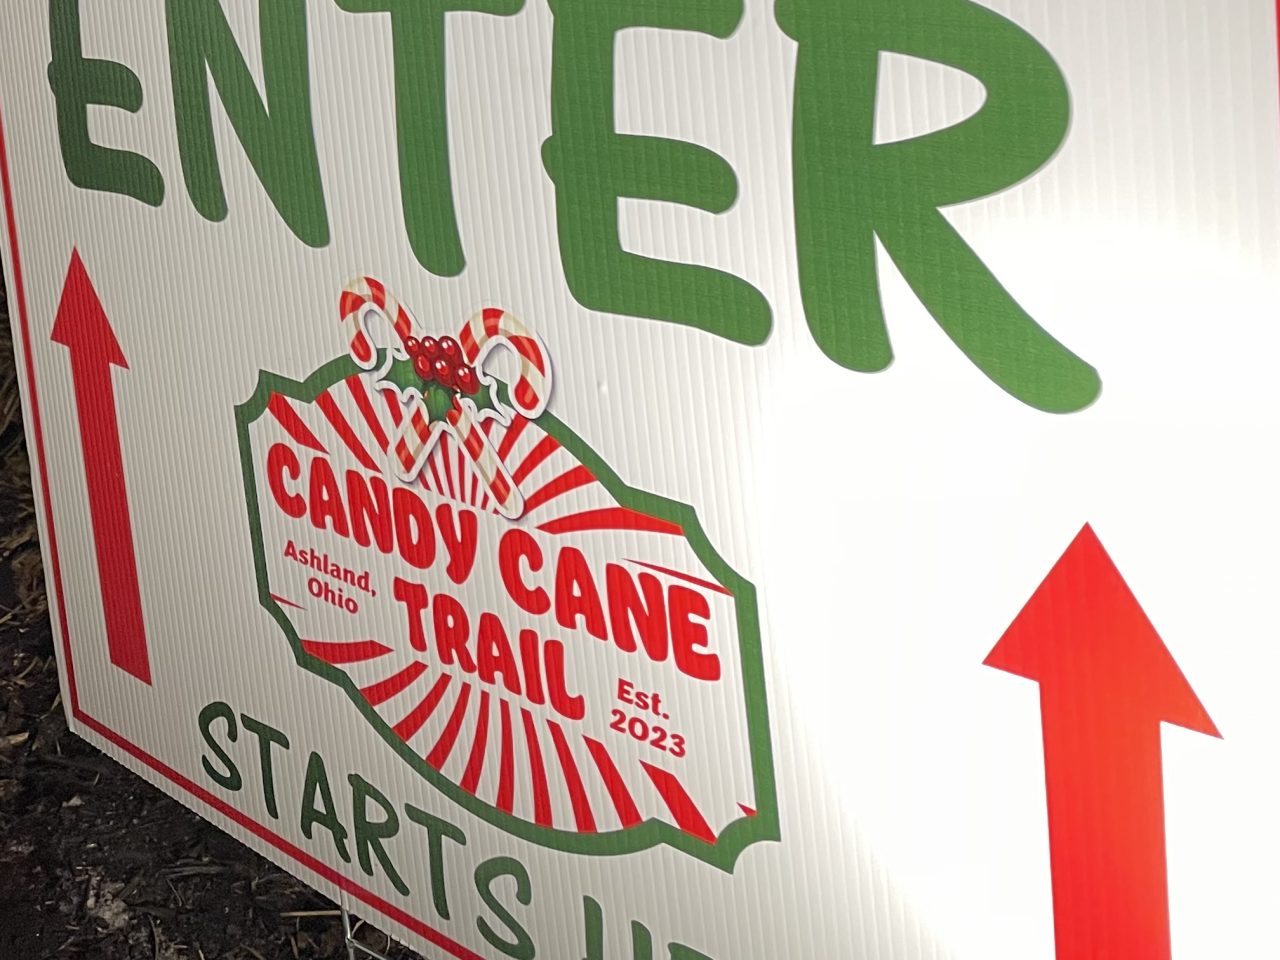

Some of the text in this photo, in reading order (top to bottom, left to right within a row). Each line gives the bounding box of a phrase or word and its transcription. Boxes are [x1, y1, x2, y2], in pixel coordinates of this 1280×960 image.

[266, 442, 721, 682] CANDY CANE
[283, 539, 377, 599] Ashland,
[307, 576, 359, 615] Ohio
[393, 576, 586, 721] TRAIL
[617, 677, 670, 720] Est.
[609, 708, 687, 759] 2023
[198, 701, 536, 959] STARTS
